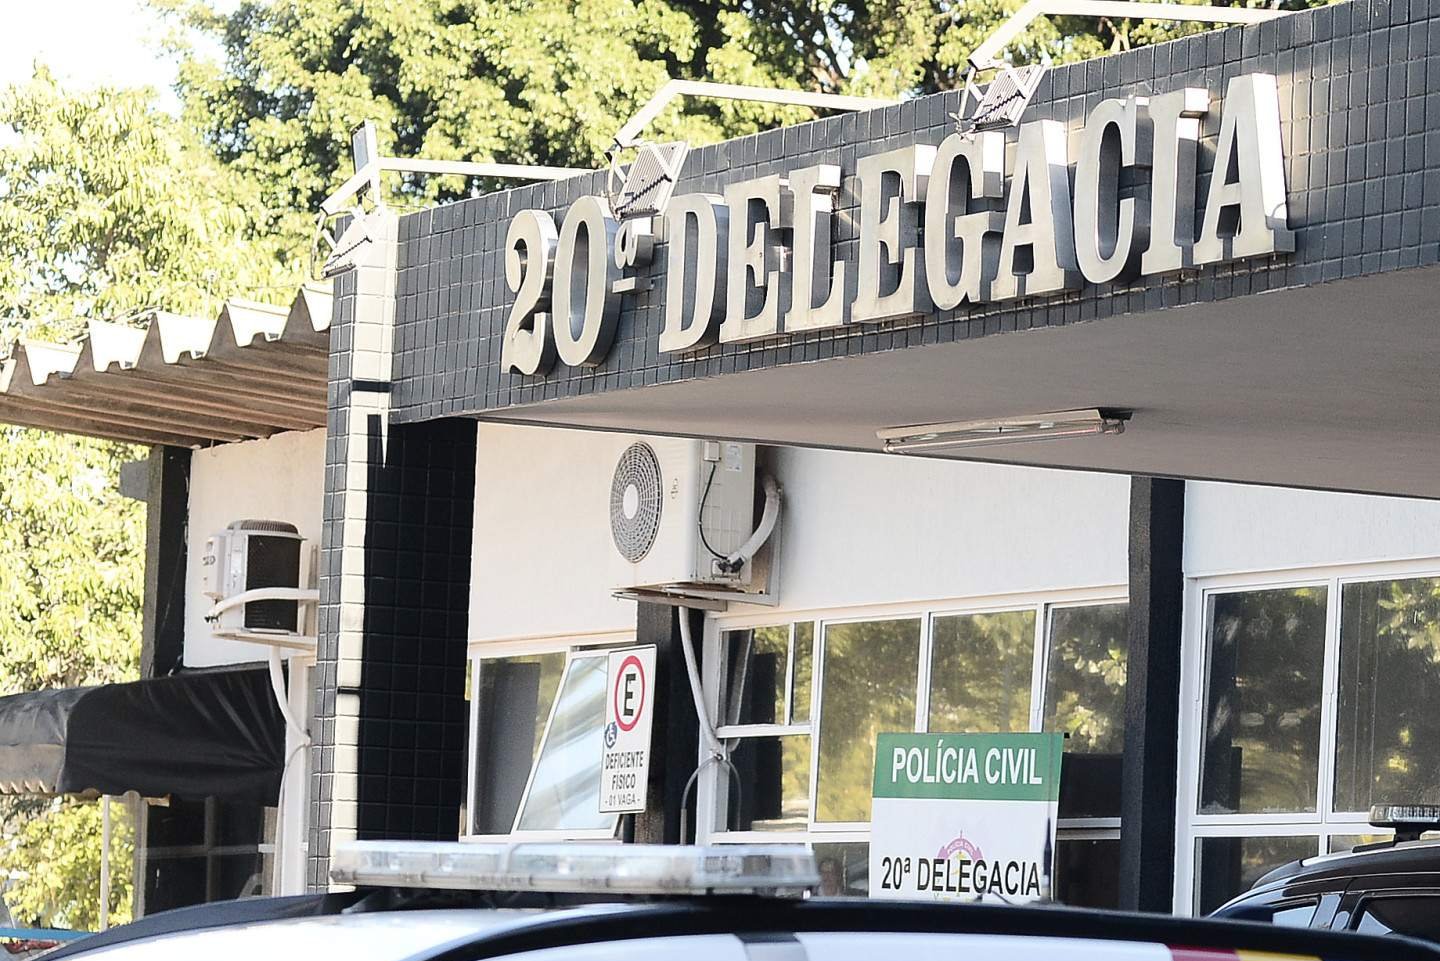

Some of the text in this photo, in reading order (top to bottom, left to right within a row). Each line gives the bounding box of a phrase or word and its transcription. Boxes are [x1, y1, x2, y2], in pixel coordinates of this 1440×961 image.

[658, 73, 1294, 354] DELEGACIA
[623, 673, 637, 717] E
[605, 751, 644, 770] DEFICIENTE
[892, 739, 1043, 785] POLÍCIA CIVIL
[881, 856, 1041, 897] 20ª DELEGACIA
